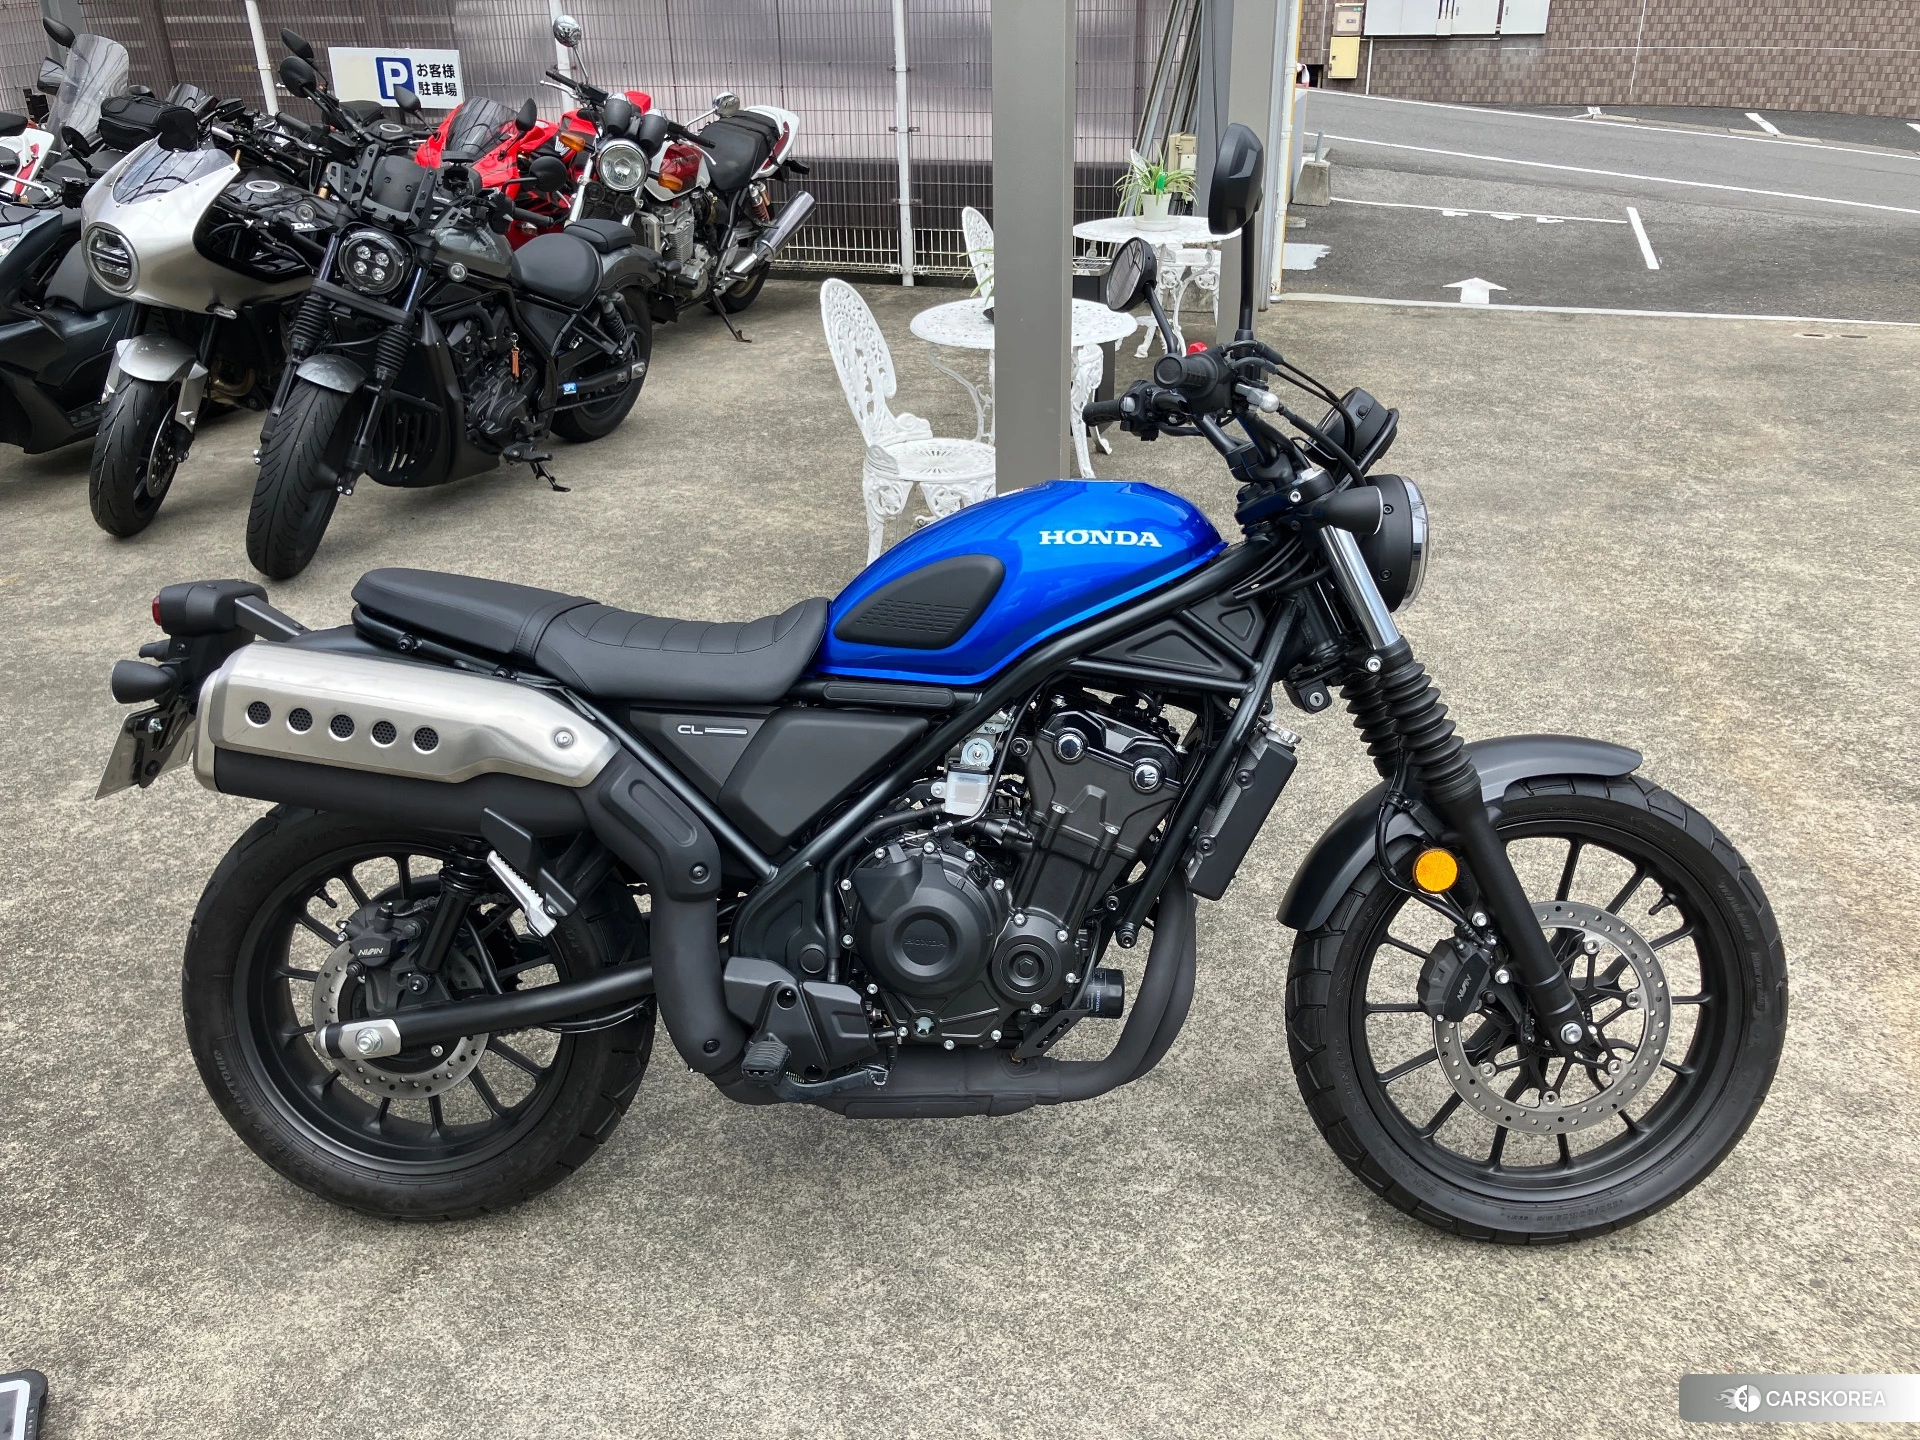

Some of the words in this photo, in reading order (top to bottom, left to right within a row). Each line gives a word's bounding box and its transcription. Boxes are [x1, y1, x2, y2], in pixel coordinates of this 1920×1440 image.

[382, 61, 409, 97] P
[416, 63, 456, 79] お客様
[417, 82, 458, 97] 駐車場
[1039, 529, 1163, 548] HONDA
[677, 724, 704, 735] CL
[904, 937, 947, 948] HONDA
[213, 1049, 253, 1116] MIXTOUR
